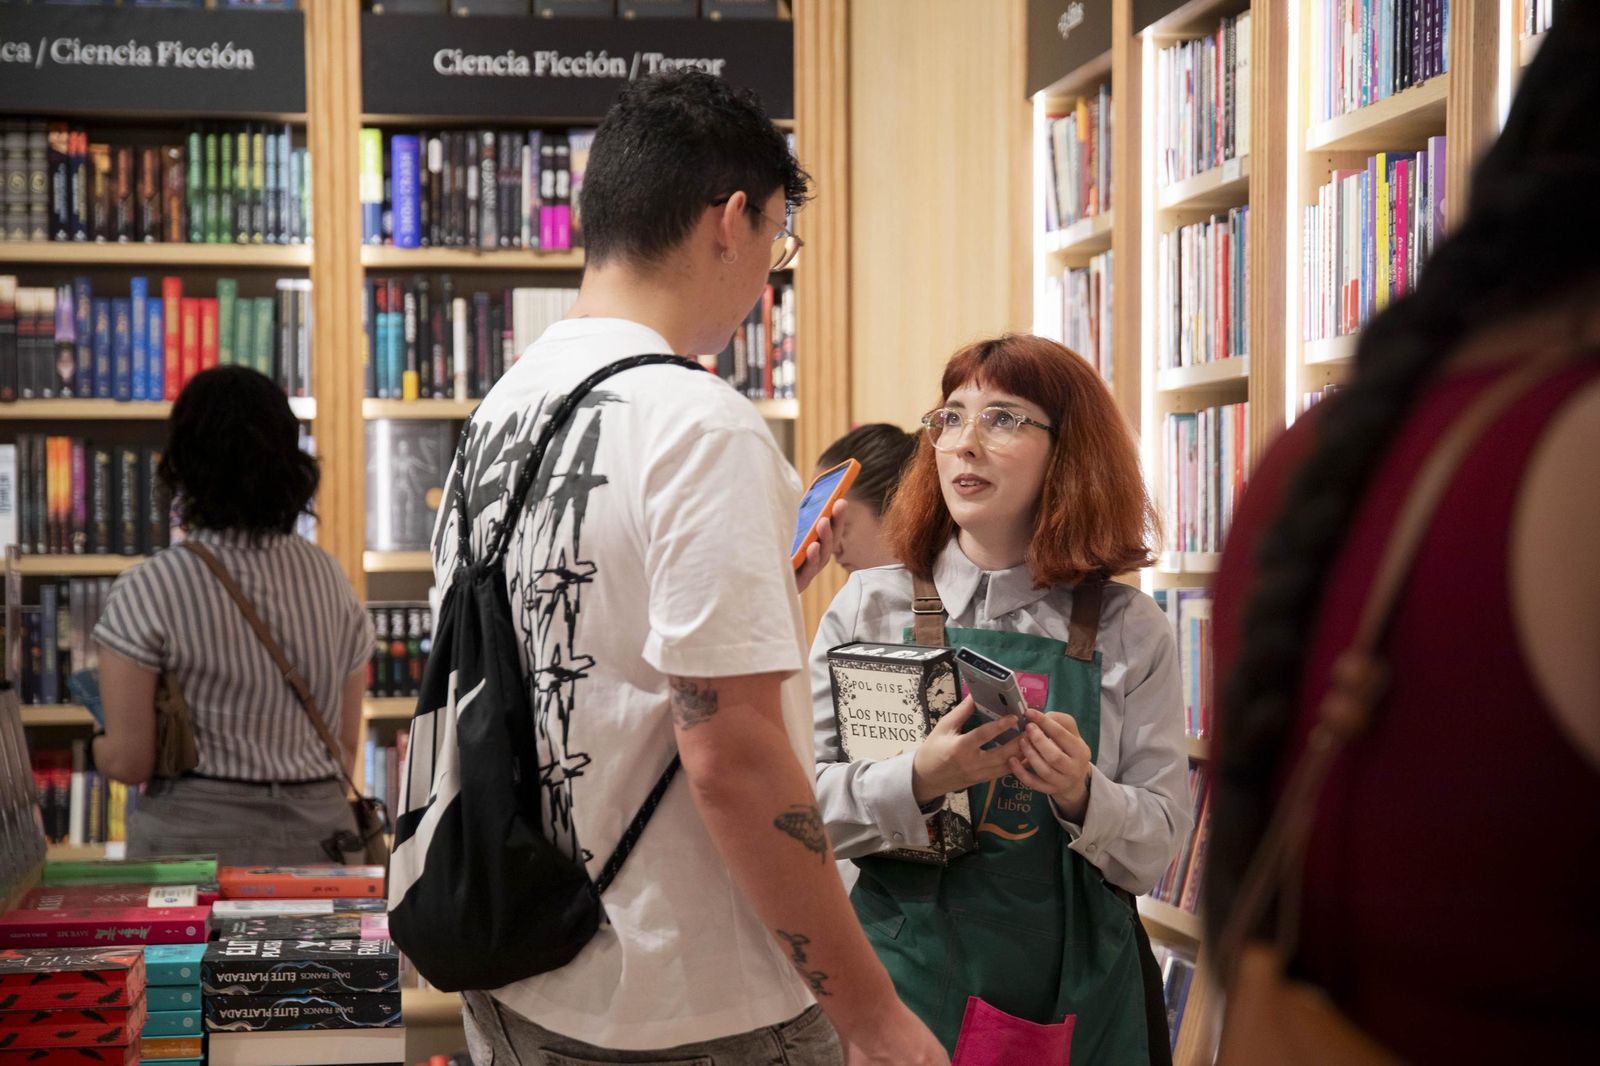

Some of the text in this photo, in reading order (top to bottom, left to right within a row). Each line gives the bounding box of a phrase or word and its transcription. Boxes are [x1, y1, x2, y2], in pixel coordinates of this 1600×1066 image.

[0, 41, 31, 63] ca
[50, 37, 152, 66] Ciencia
[156, 40, 254, 69] Ficción
[433, 48, 530, 77] Ciencia
[534, 49, 627, 78] Ficción
[852, 680, 904, 694] POL GISE
[848, 708, 915, 725] LOS MITOS
[850, 723, 917, 742] ETERNOS
[1015, 791, 1033, 802] del
[997, 796, 1032, 813] Libro
[217, 972, 269, 983] PLATEADA
[271, 971, 297, 983] ÉLITE
[300, 971, 330, 979] FRANCIS
[220, 1007, 272, 1019] PLATEADA
[273, 1007, 300, 1019] ÉLITE
[303, 1006, 333, 1015] FRANCIS
